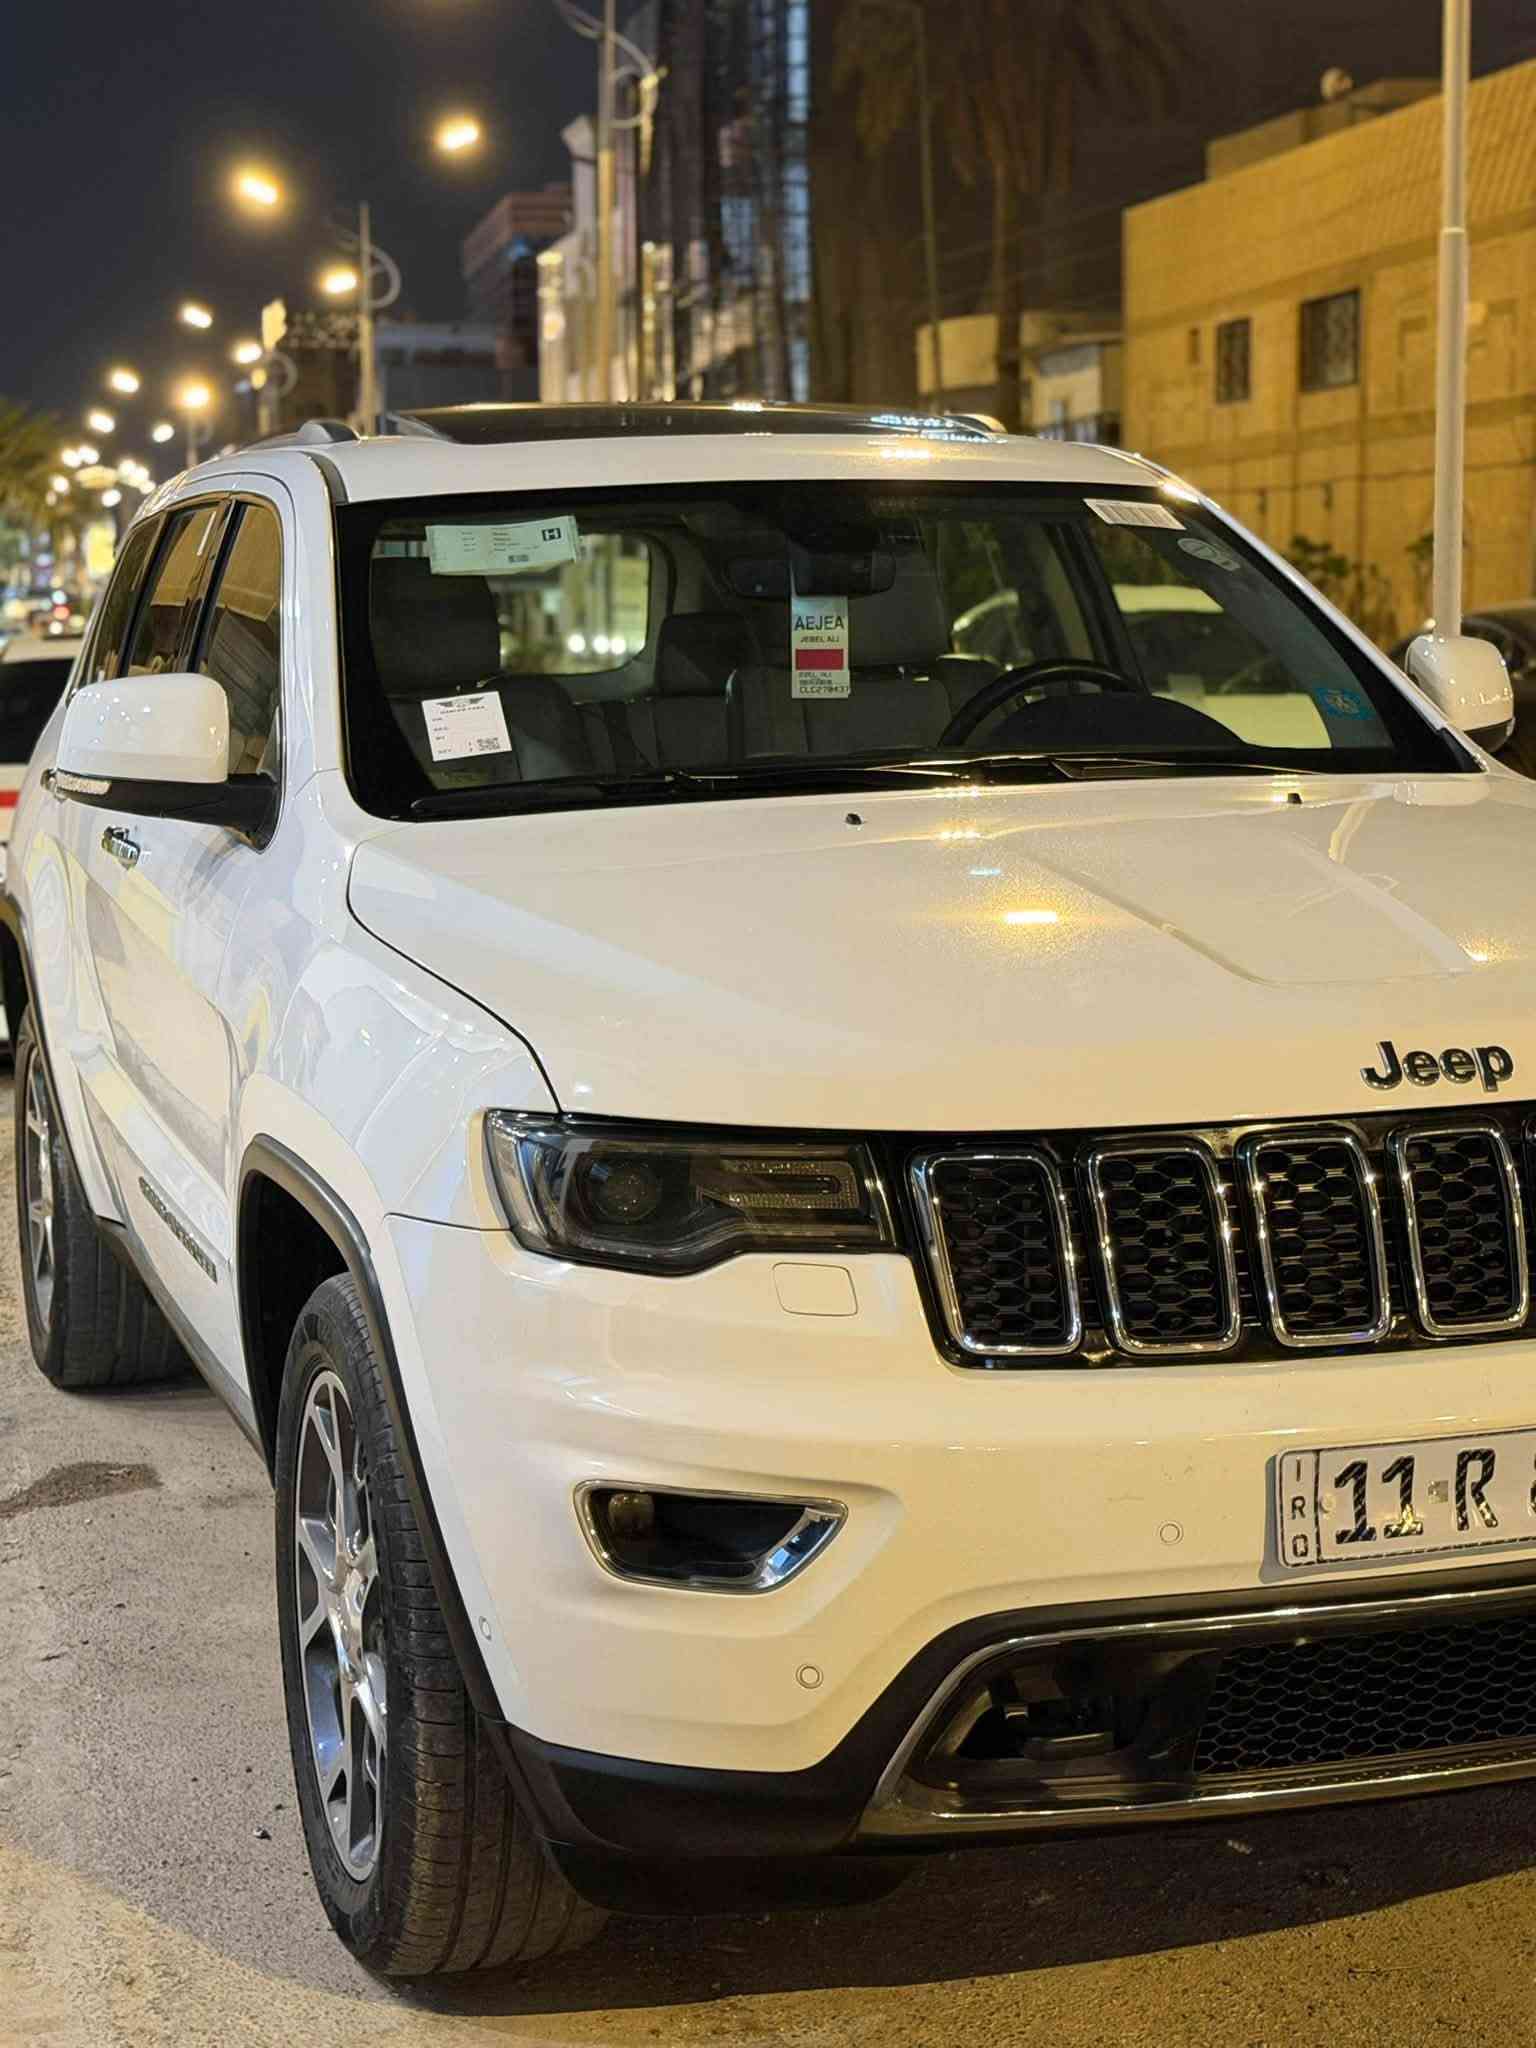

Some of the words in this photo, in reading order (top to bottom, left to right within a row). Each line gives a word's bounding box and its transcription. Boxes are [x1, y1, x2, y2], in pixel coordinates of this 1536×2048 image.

[794, 616, 844, 631] AEJEA
[1360, 1040, 1513, 1092] Jeep
[1334, 1455, 1424, 1544] 11
[1455, 1448, 1498, 1531] R
